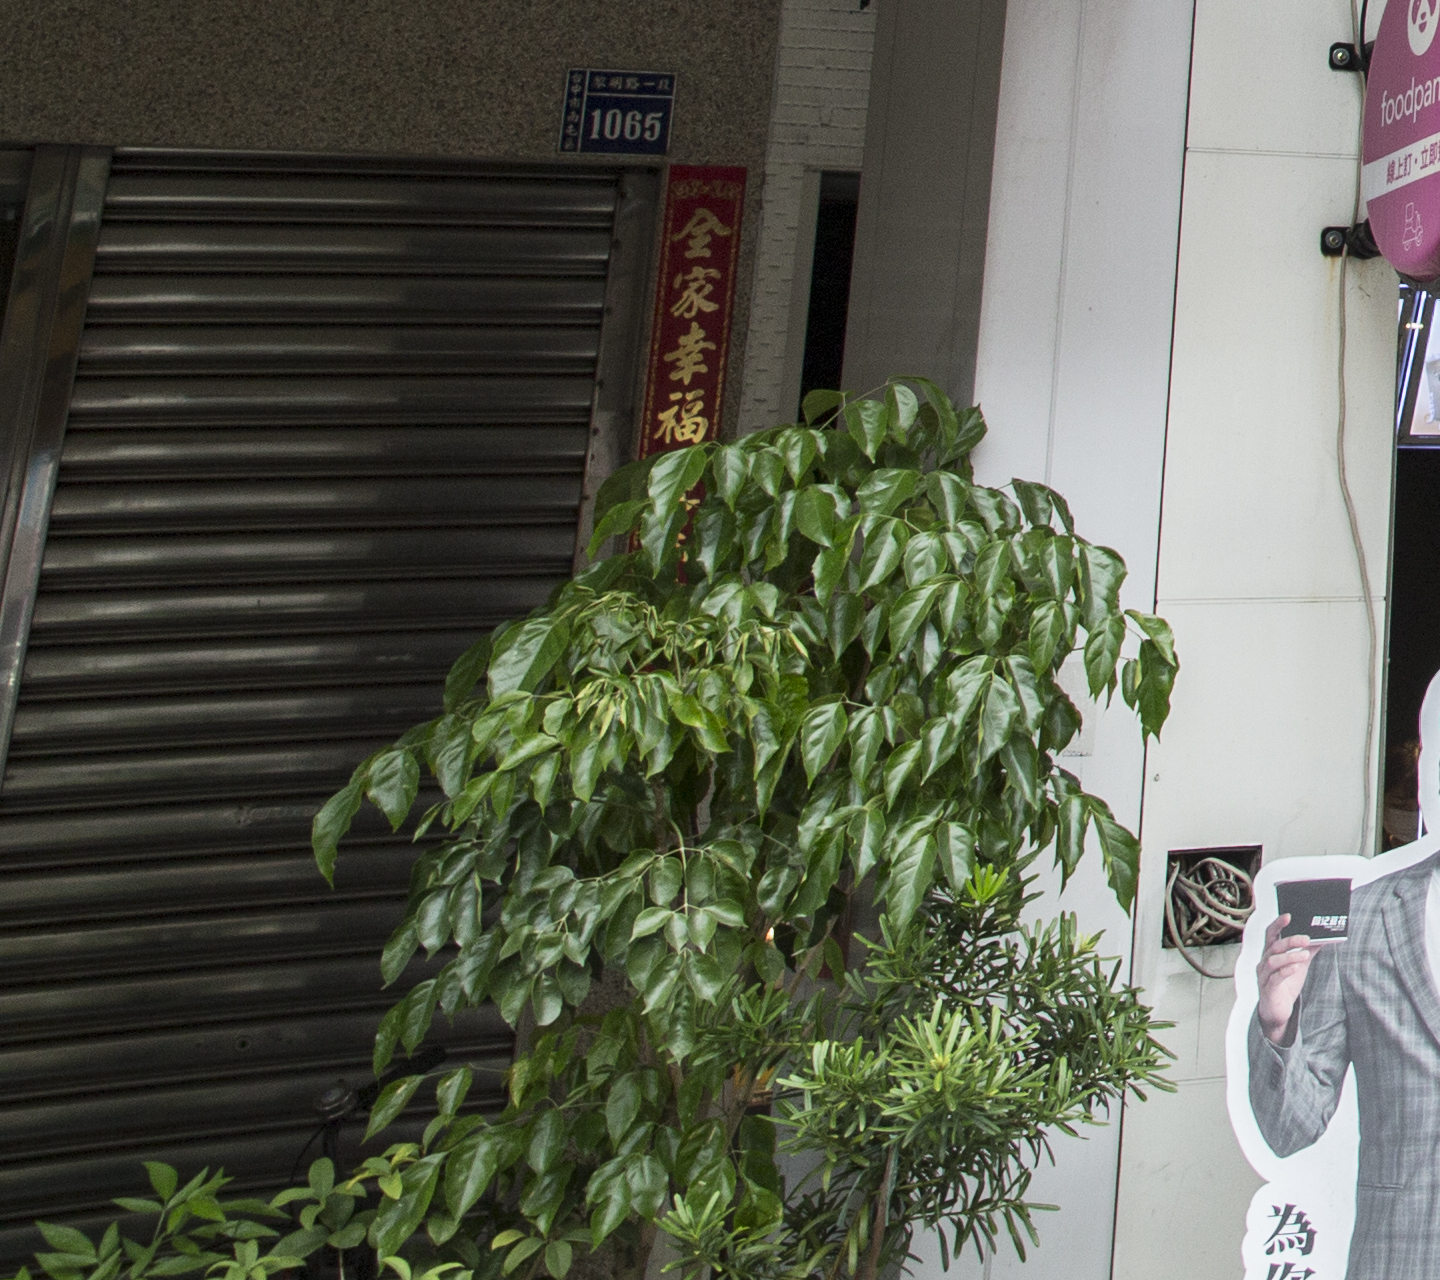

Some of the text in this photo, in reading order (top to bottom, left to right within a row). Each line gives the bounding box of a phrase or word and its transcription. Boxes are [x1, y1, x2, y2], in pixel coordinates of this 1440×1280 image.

[589, 109, 663, 141] 1065
[654, 207, 733, 444] 全家幸福
[1263, 1203, 1318, 1280] 為
